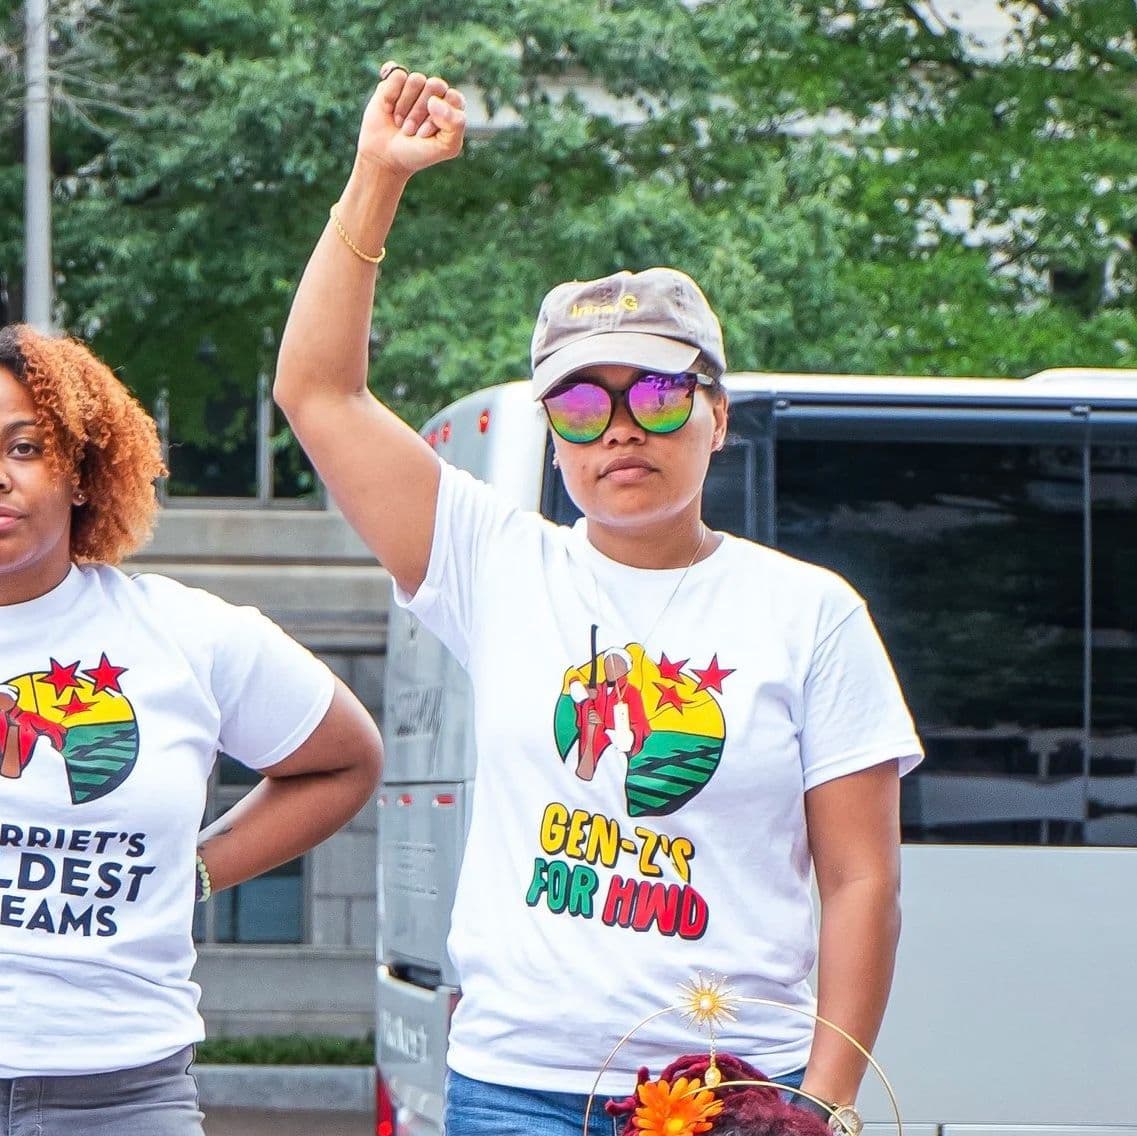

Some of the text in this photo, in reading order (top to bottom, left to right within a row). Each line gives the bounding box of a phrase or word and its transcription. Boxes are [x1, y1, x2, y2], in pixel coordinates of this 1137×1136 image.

[540, 802, 695, 885] GEN-Z'S
[525, 857, 709, 941] FOR HWD
